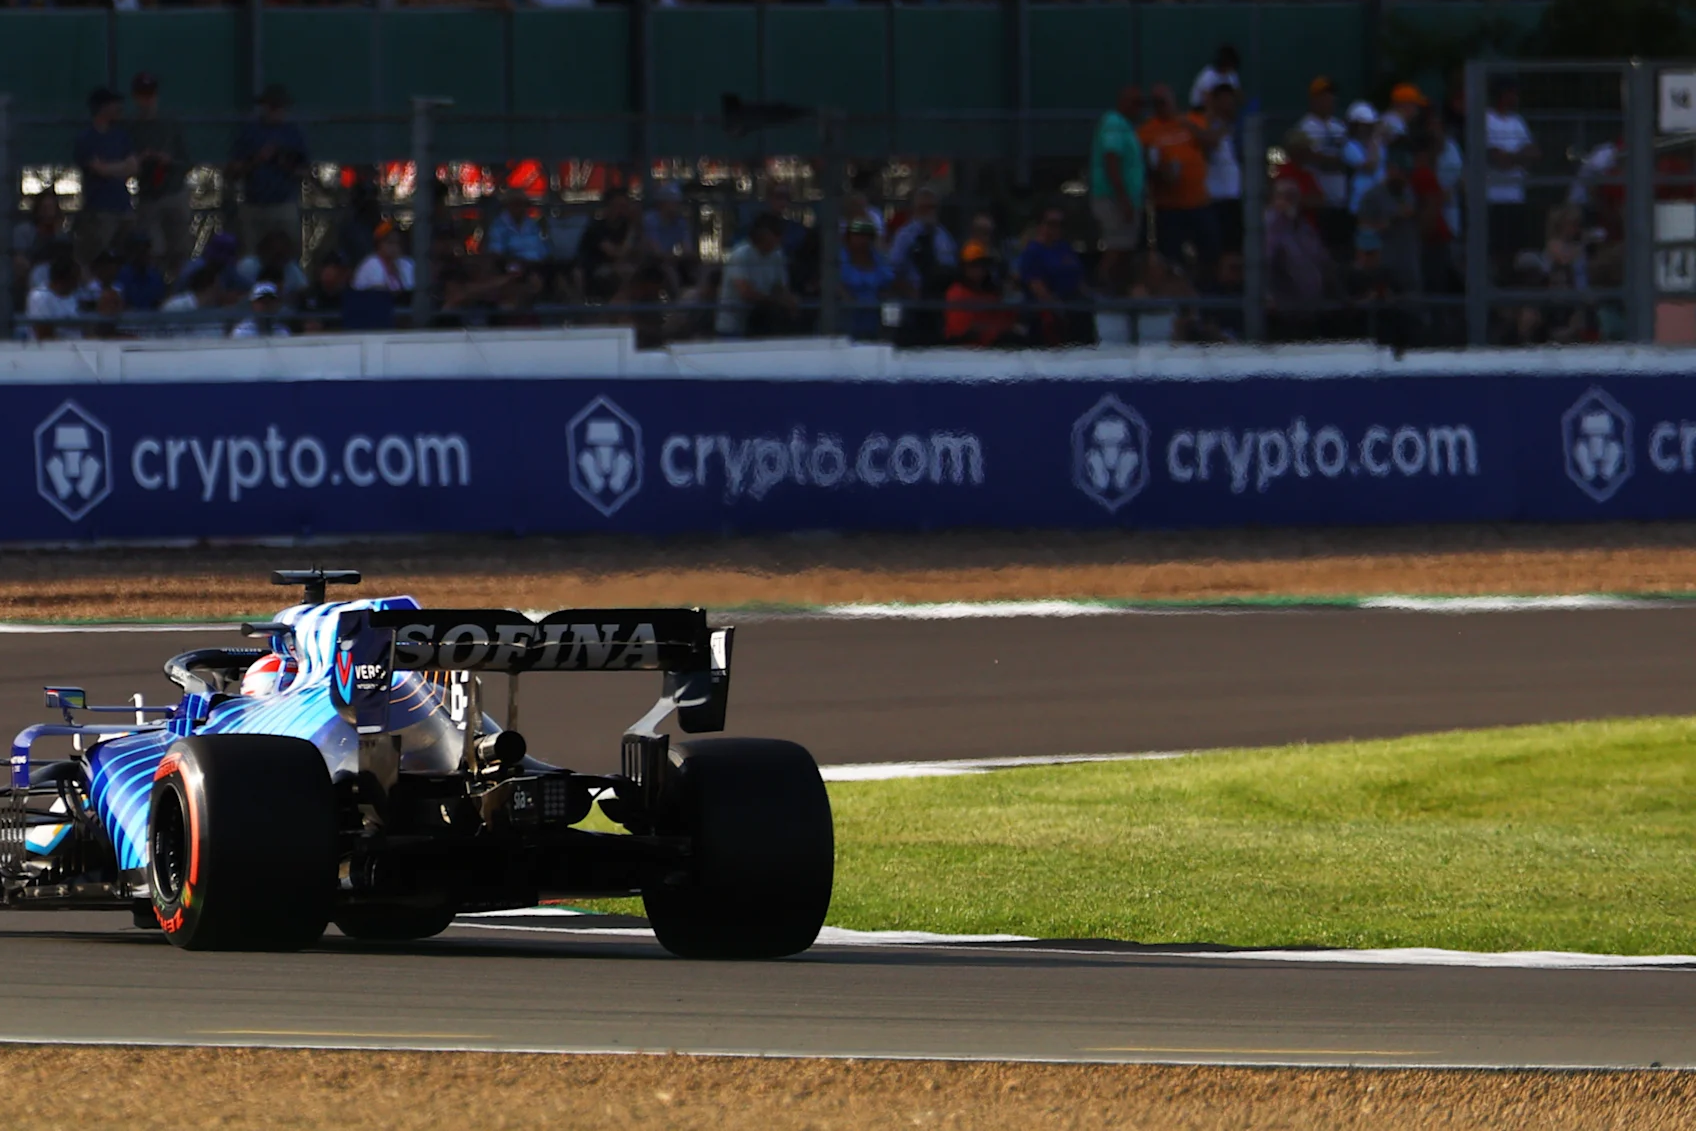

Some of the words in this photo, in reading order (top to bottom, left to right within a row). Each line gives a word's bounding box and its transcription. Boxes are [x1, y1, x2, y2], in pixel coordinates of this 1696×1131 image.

[132, 426, 470, 502] crypto.com
[661, 428, 984, 500] crypto.com
[1167, 420, 1478, 493] crypto.com
[395, 623, 658, 670] SOFINA
